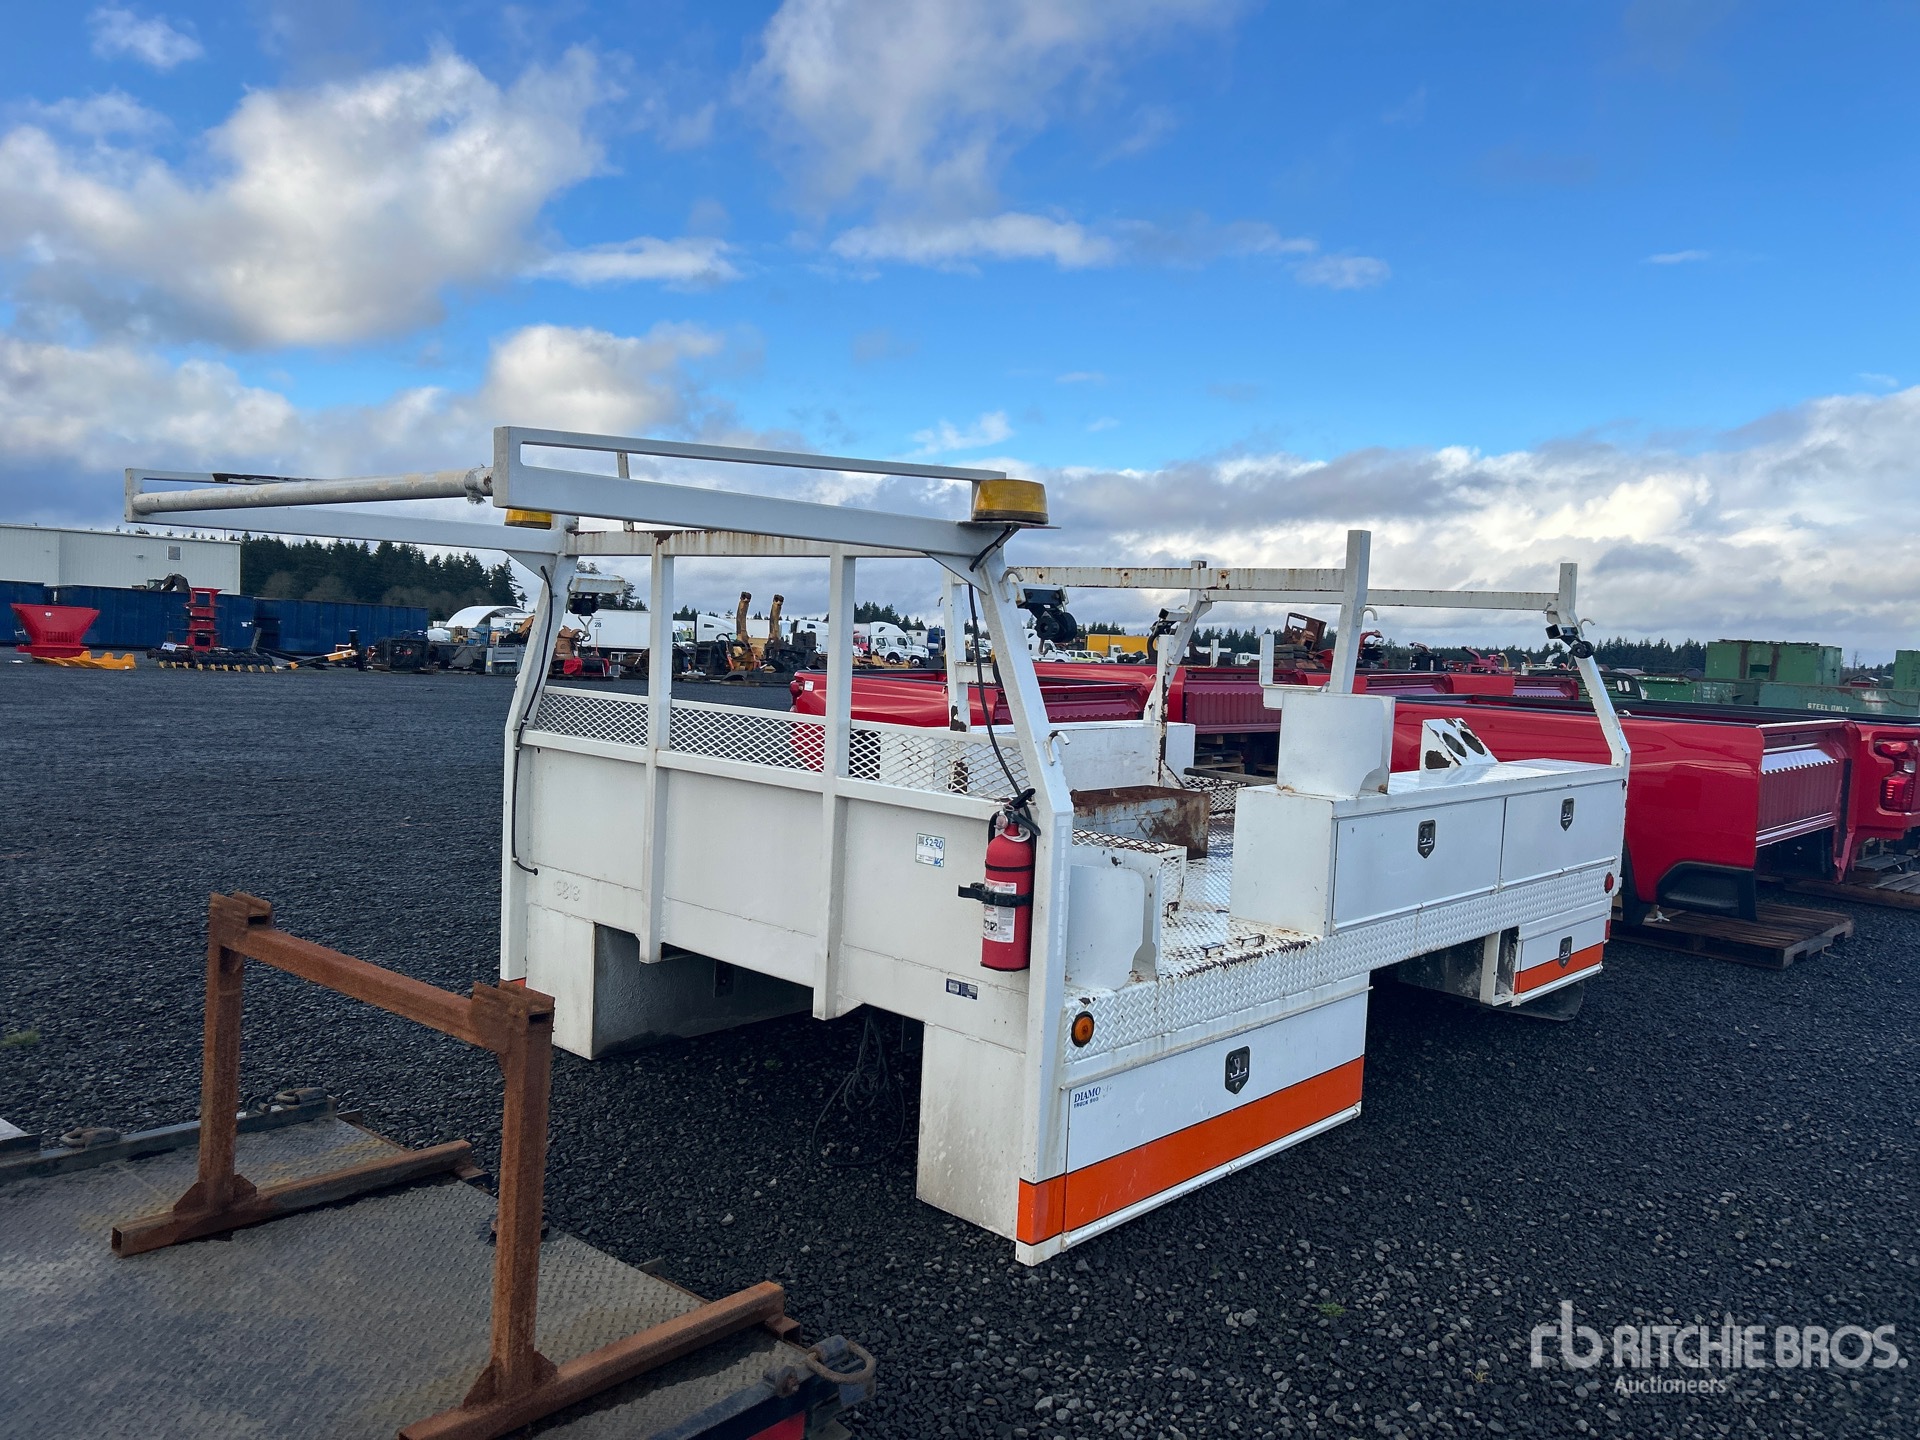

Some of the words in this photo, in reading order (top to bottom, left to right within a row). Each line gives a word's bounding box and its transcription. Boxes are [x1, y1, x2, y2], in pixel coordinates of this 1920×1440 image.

[1807, 702, 1829, 711] STEEL
[1830, 704, 1850, 713] ONLY
[1073, 1099, 1089, 1109] TRUCK
